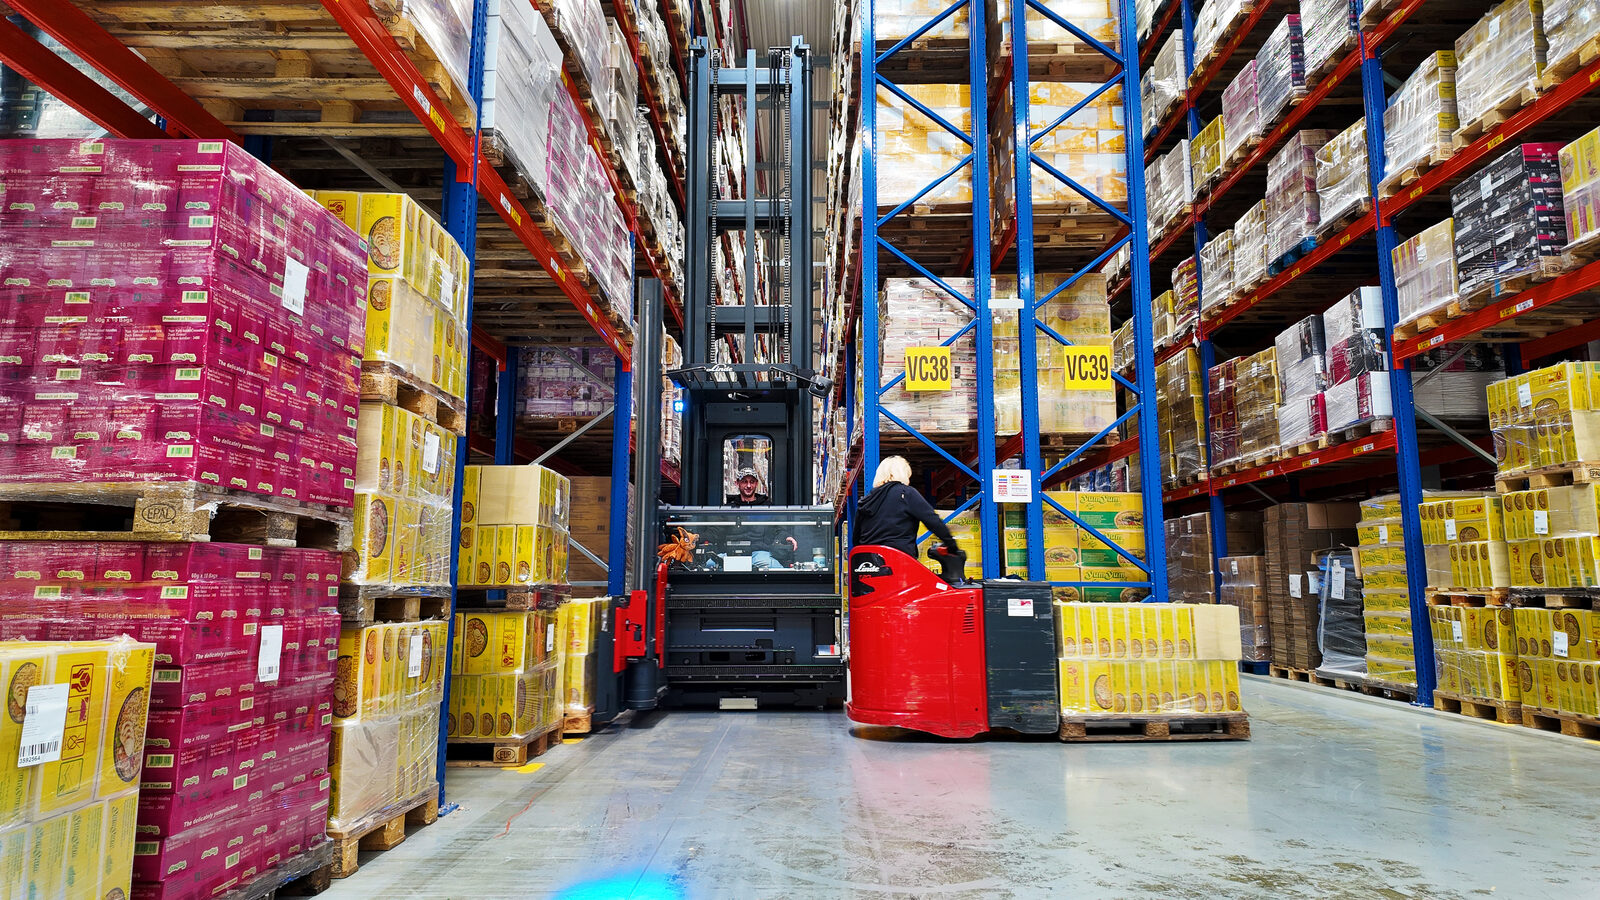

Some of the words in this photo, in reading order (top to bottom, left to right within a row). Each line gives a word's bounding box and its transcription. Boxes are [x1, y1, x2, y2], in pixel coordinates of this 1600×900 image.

[907, 356, 948, 381] VC38
[1066, 355, 1108, 380] VC39
[147, 508, 171, 519] EPAL
[854, 562, 880, 572] Linde
[500, 750, 512, 759] EUR
